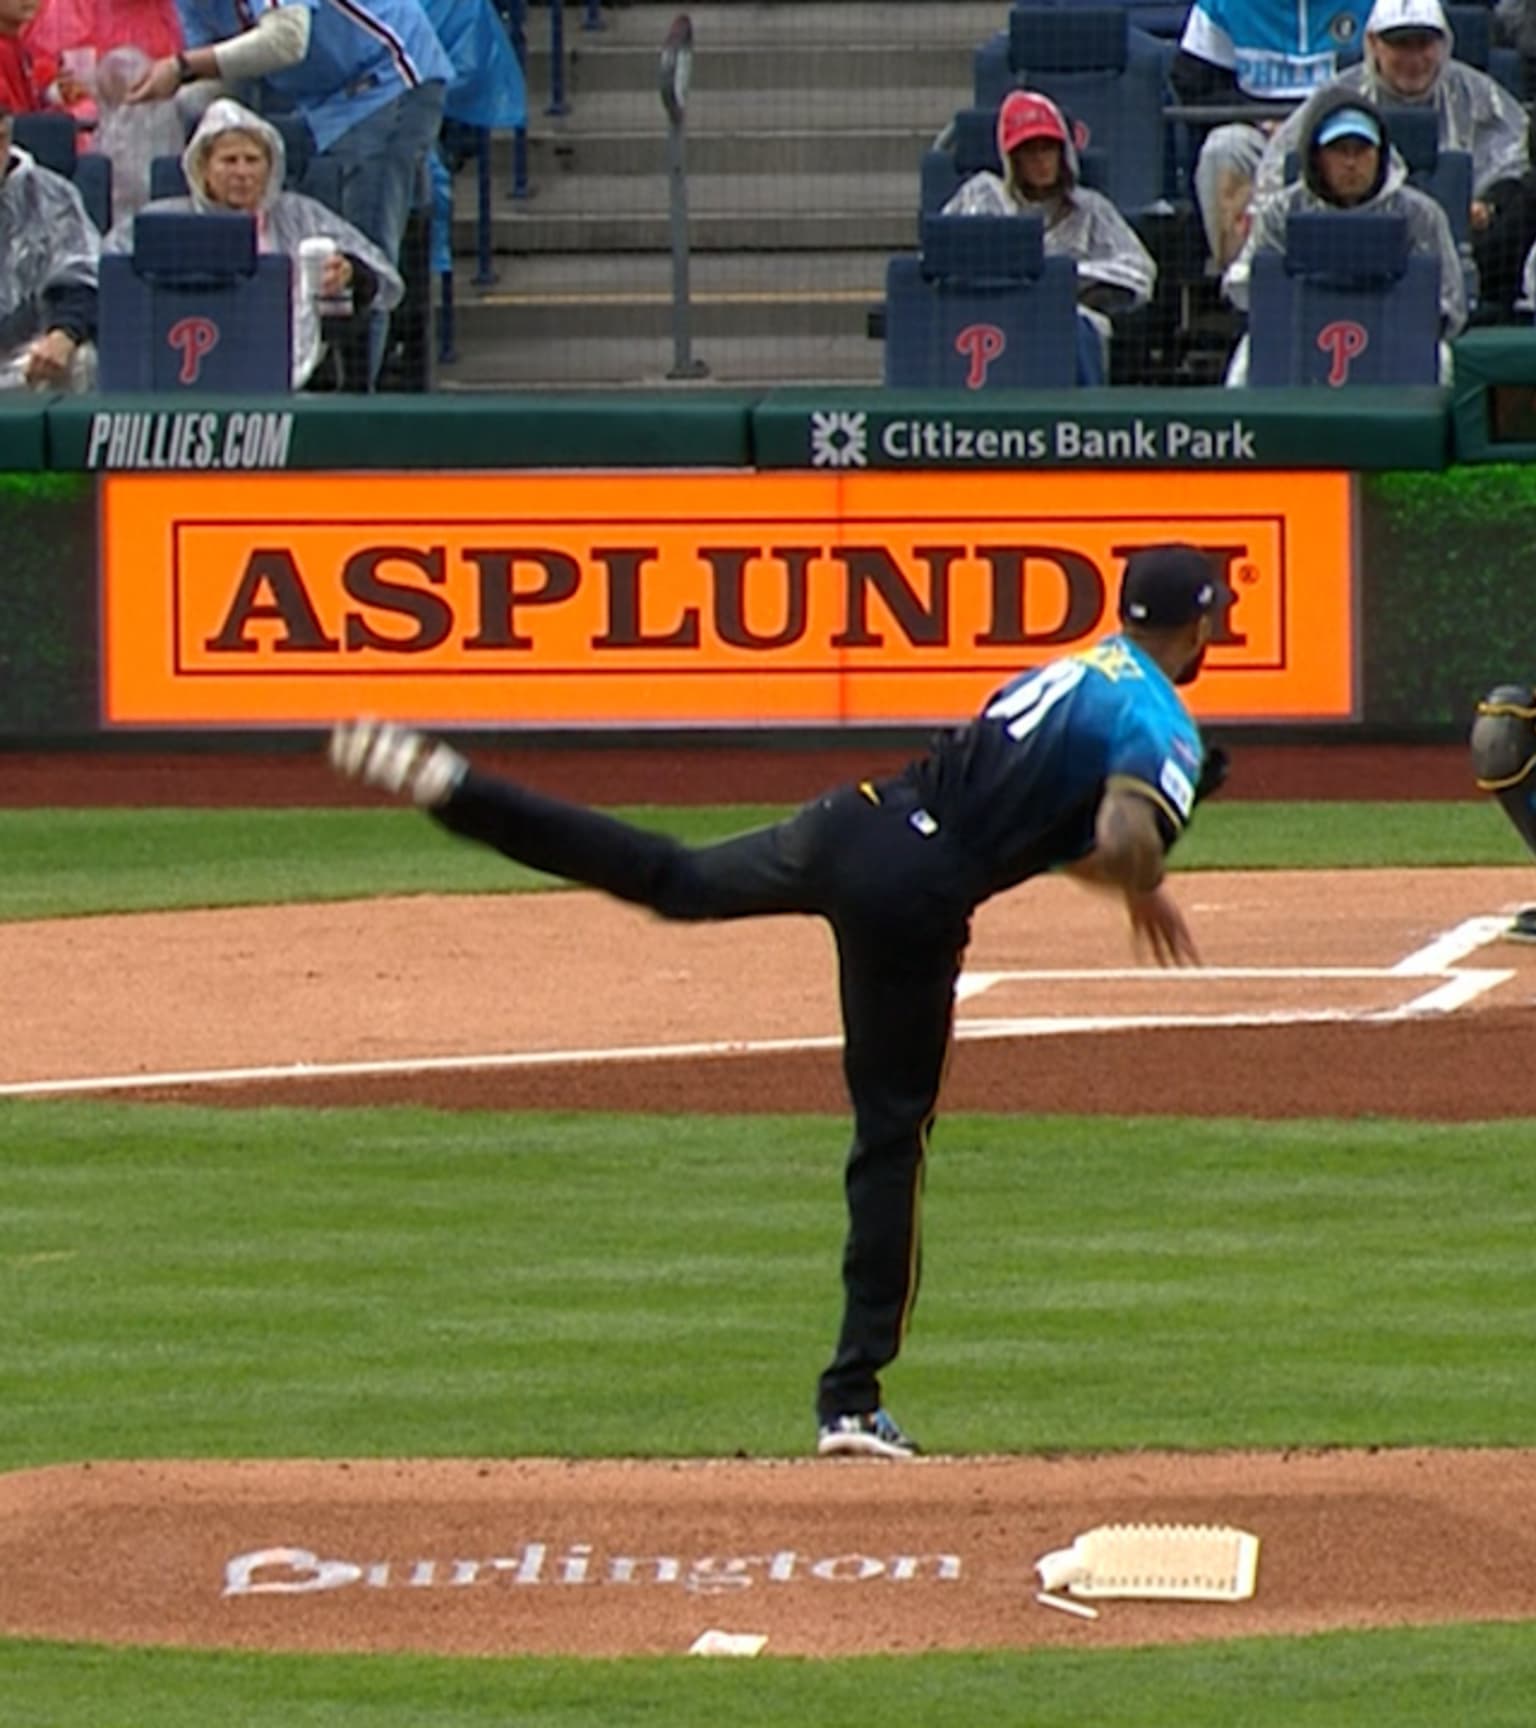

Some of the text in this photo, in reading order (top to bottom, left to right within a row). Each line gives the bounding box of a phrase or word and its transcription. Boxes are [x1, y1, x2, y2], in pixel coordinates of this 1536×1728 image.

[167, 316, 219, 384] P
[955, 324, 1006, 389] P
[1317, 321, 1368, 387] P
[88, 412, 293, 468] PHILLIES.COM
[882, 419, 1256, 459] Citizens Bank Park
[220, 1543, 961, 1597] Burlington
